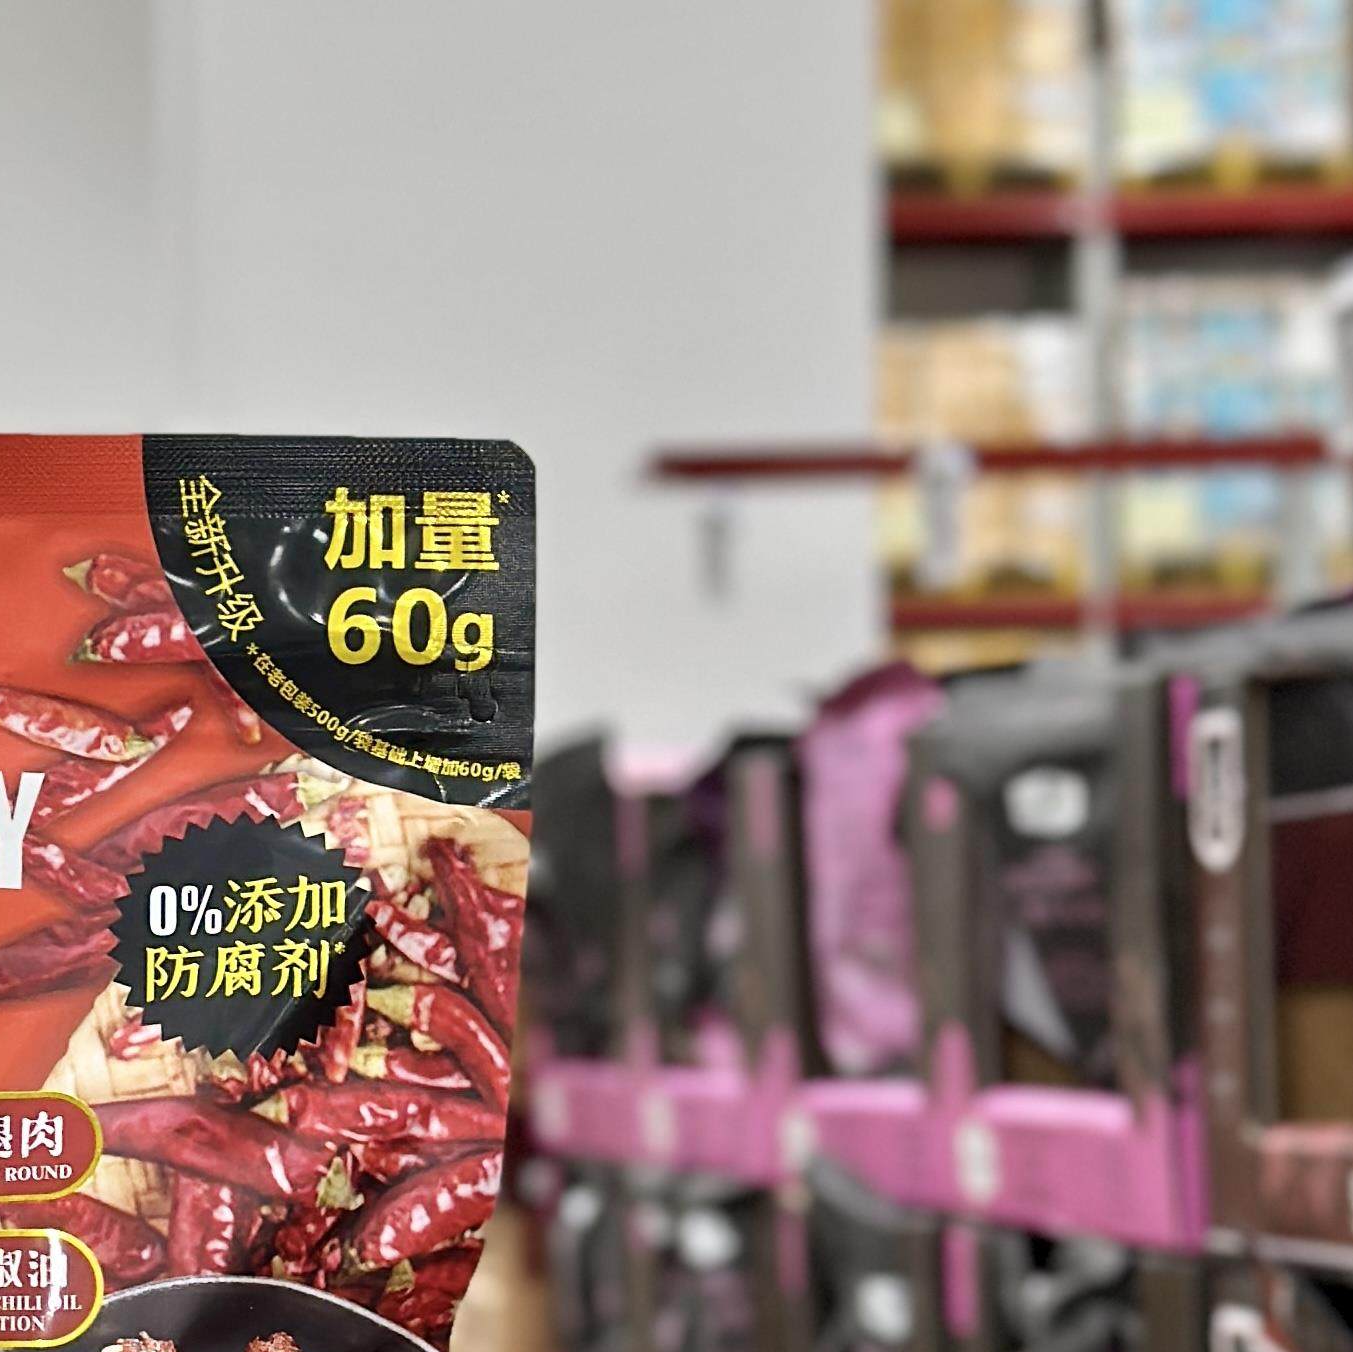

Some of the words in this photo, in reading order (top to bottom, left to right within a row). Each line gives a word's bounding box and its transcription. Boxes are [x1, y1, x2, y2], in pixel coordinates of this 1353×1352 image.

[179, 475, 265, 642] 全新升级
[327, 587, 494, 672] 60g
[149, 875, 346, 936] 0%添加
[5, 1164, 73, 1183] ROUND
